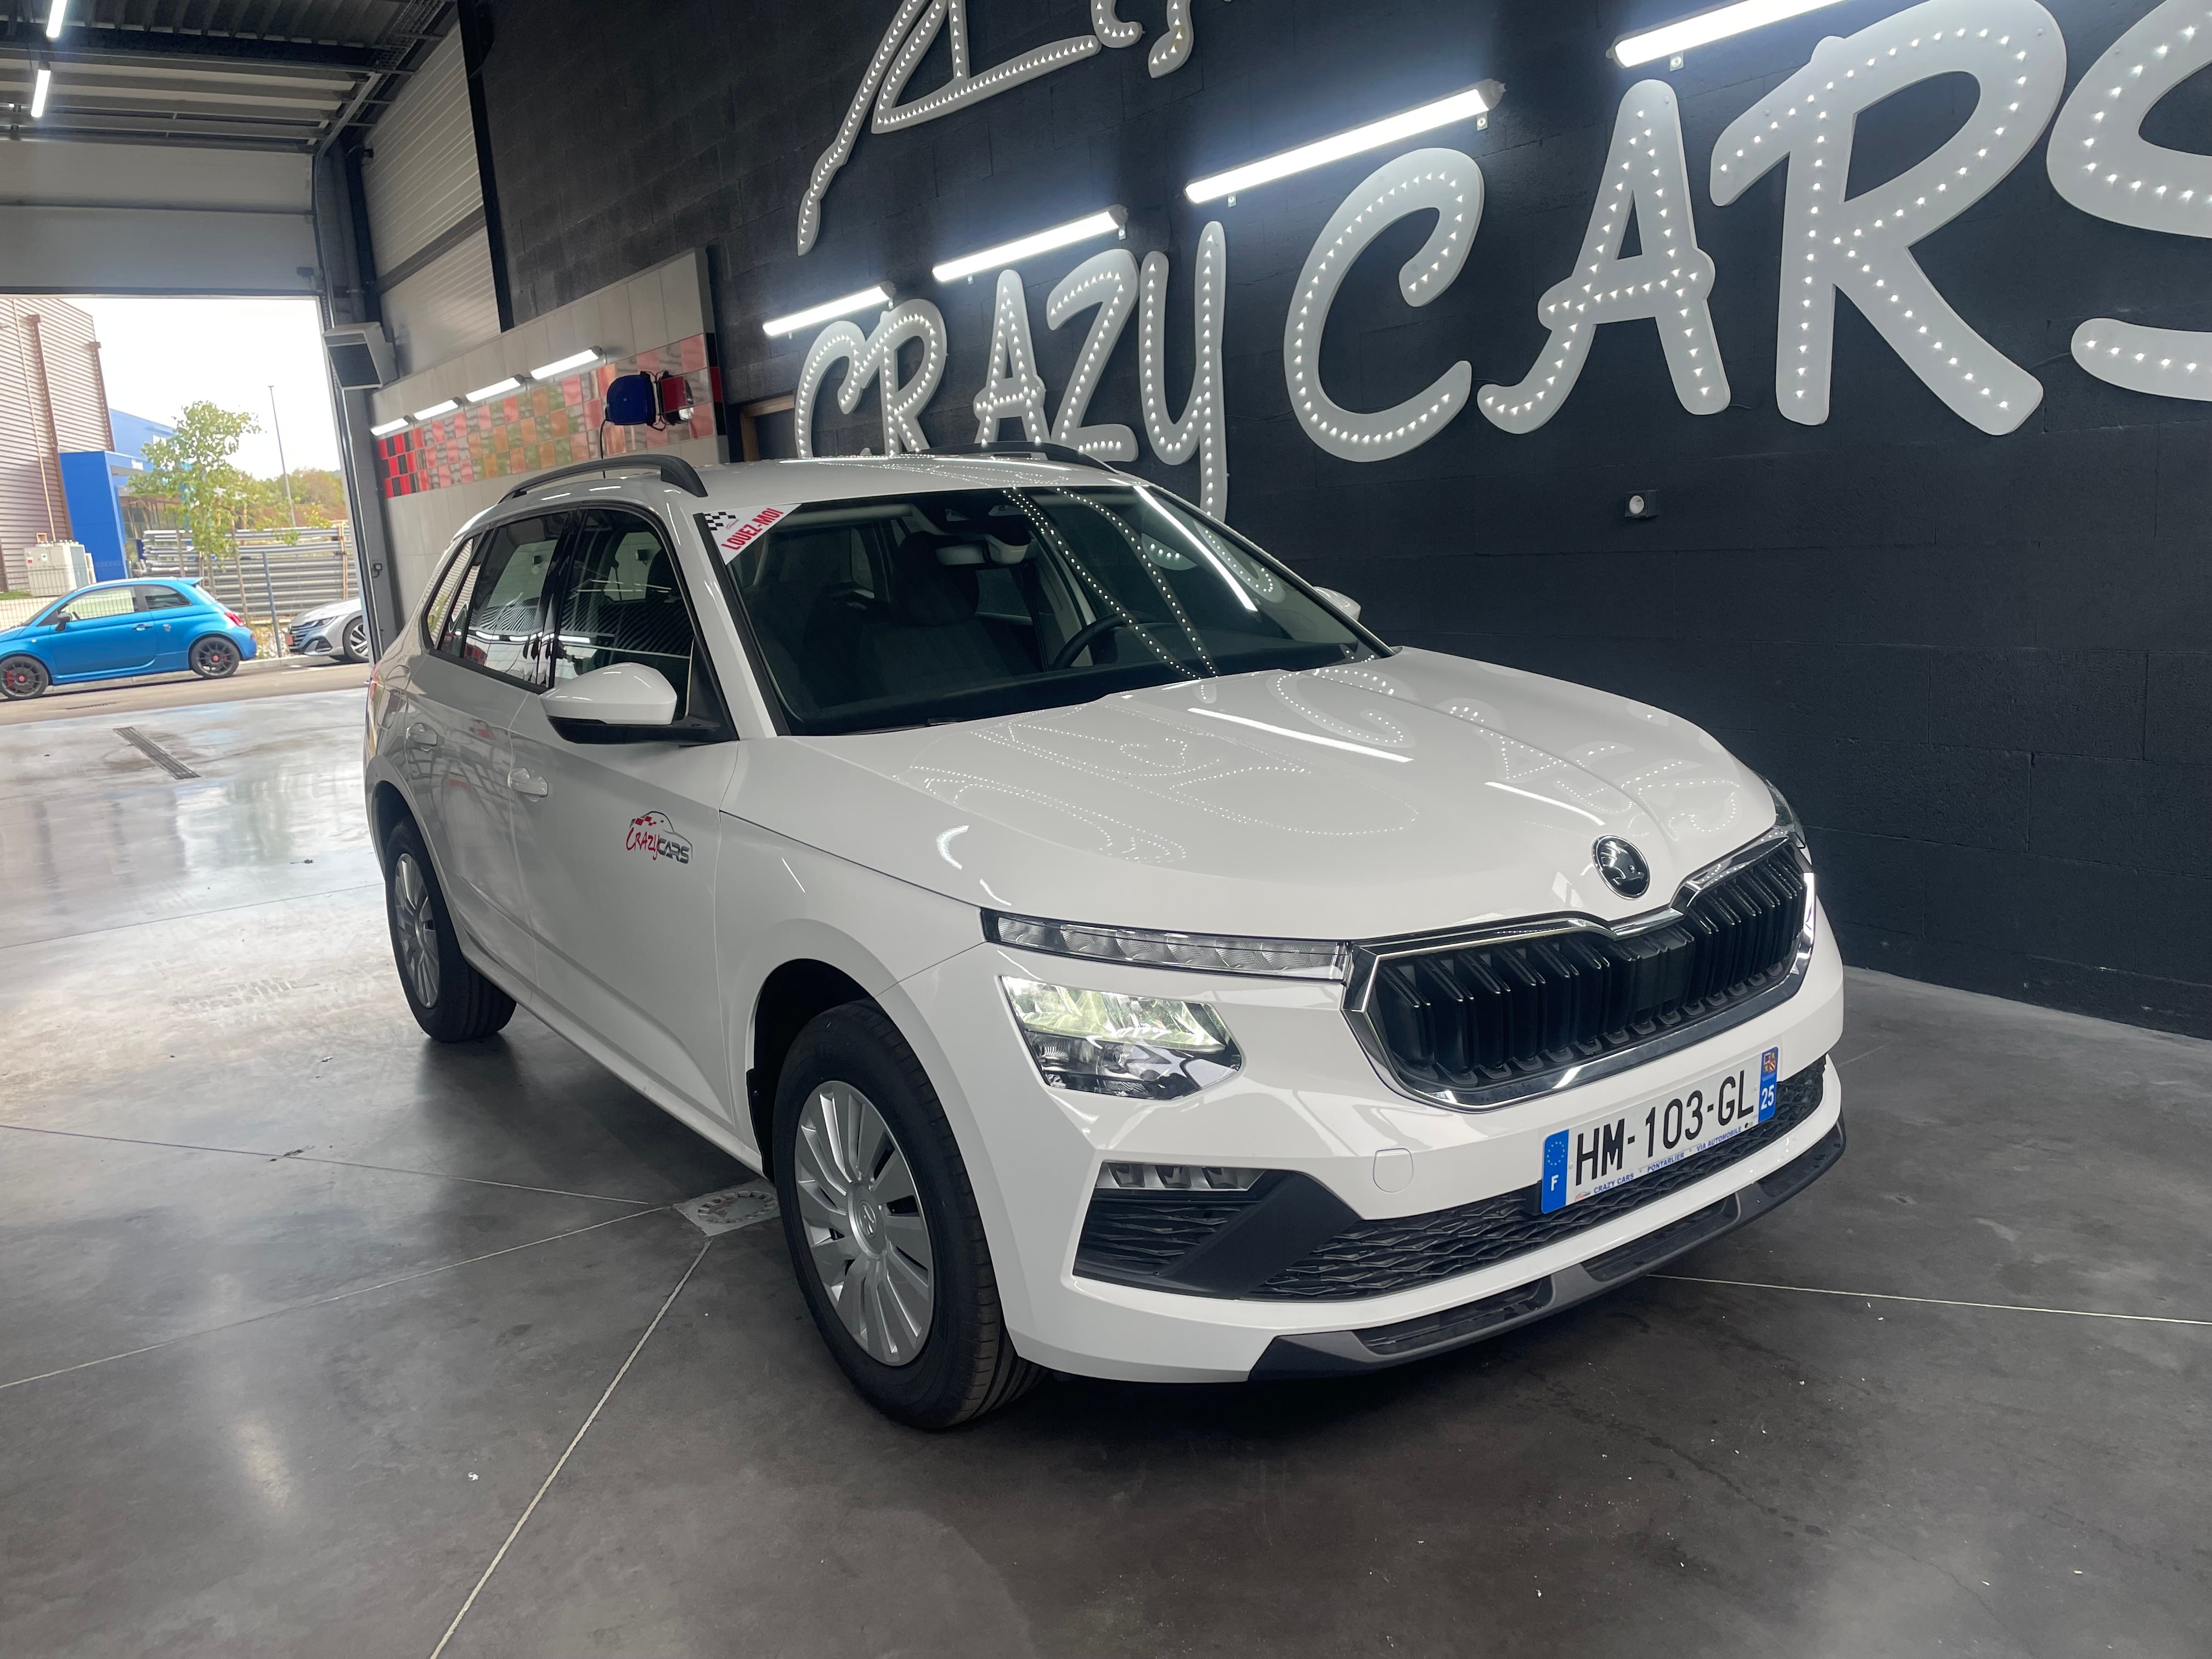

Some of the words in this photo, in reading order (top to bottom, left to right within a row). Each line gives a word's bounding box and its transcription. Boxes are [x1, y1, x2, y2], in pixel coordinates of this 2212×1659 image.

[795, 221, 1229, 522] CRAZY
[721, 507, 784, 550] LOUEZ-MOI
[1761, 1085, 1775, 1110] 25
[1576, 1070, 1754, 1186] HM-103-GL
[1550, 1175, 1559, 1191] F
[1594, 1181, 1615, 1194] CRAZY
[1617, 1173, 1634, 1184] CARS
[1647, 1152, 1685, 1172] PONTARLIER
[1696, 1143, 1706, 1152] VIA
[1707, 1126, 1742, 1147] AUTOMOBILE
